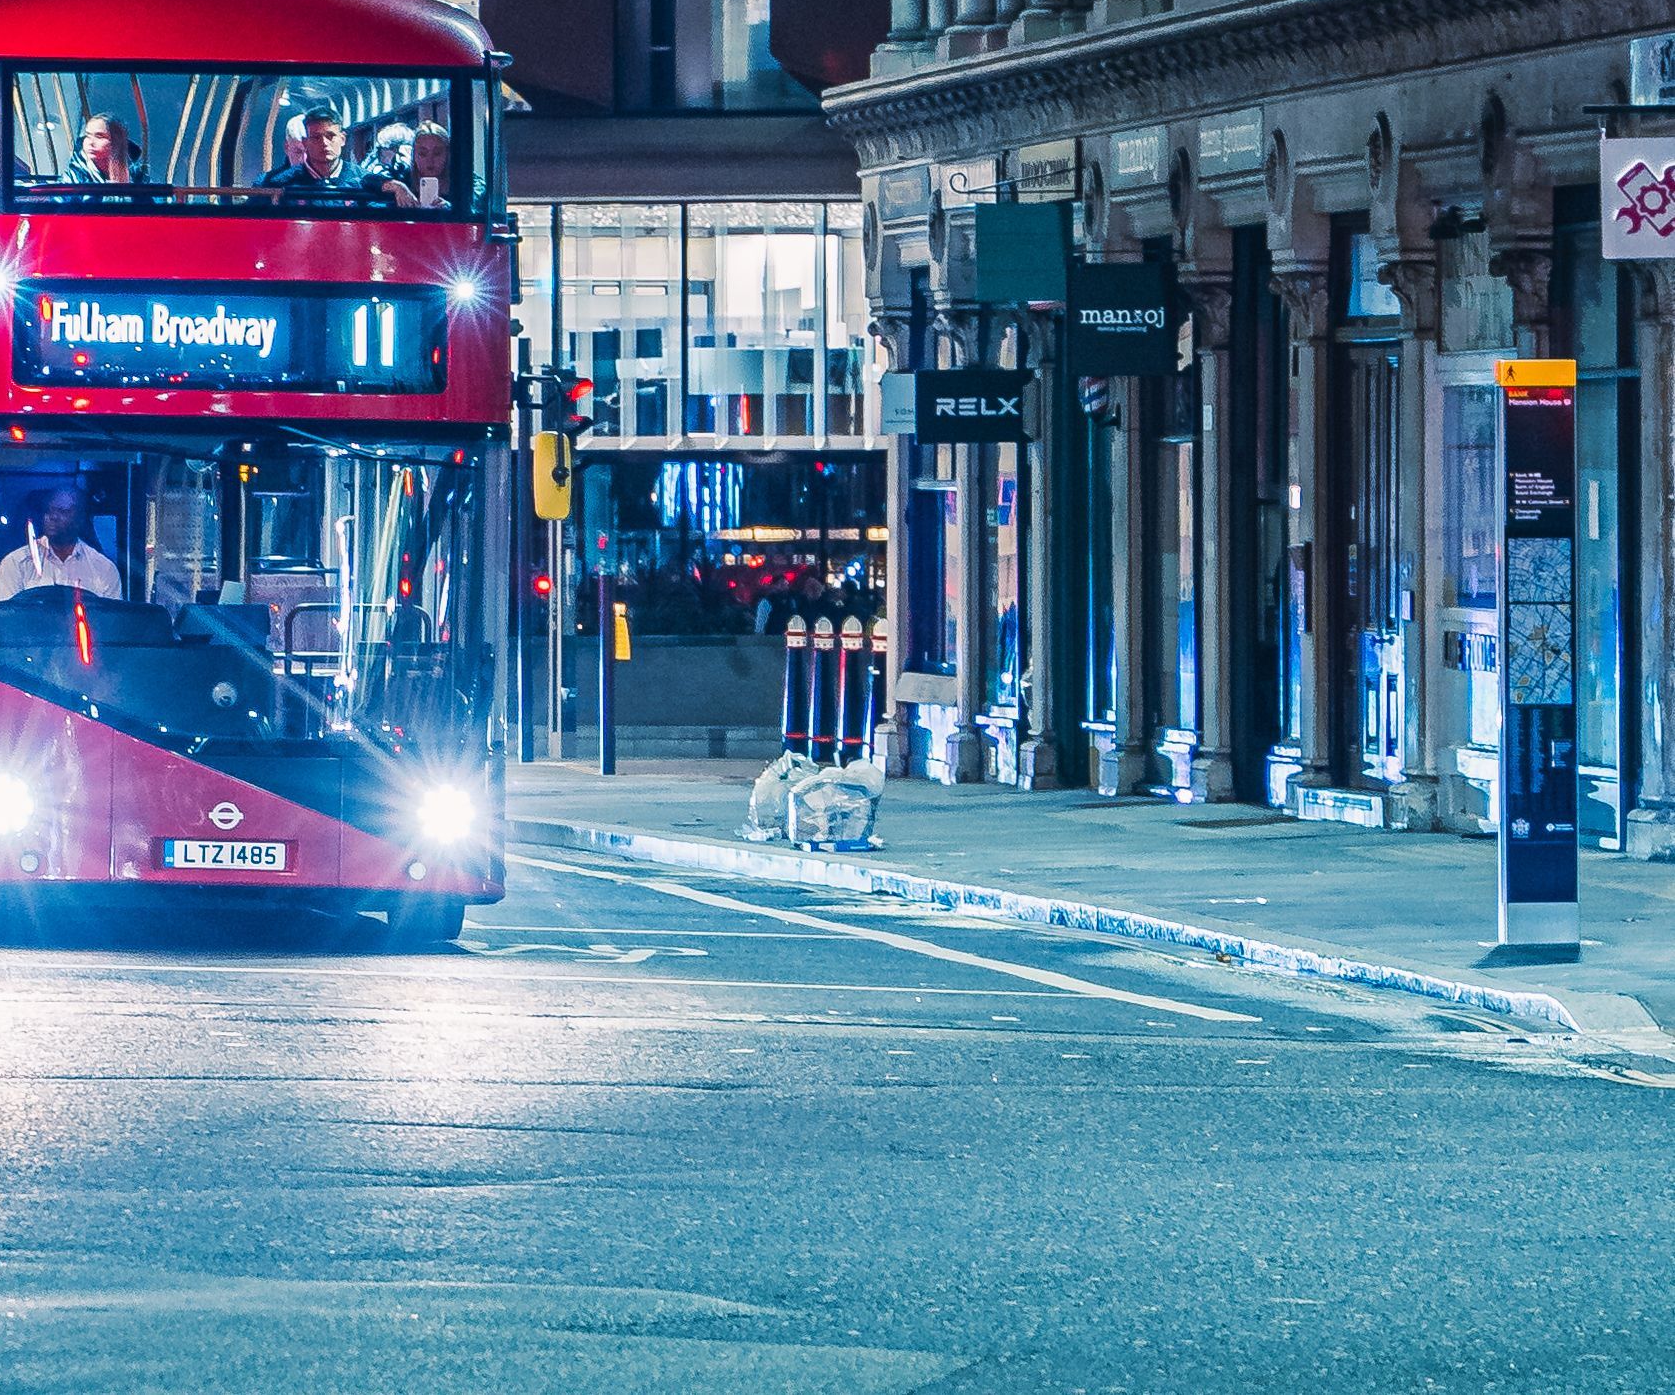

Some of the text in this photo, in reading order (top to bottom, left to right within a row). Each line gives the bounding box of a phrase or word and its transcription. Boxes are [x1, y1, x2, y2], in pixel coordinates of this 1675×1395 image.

[51, 302, 278, 359] Fulham Broadway
[353, 304, 395, 367] 11
[935, 397, 1020, 417] RELX
[183, 844, 277, 865] LTZ 1485
